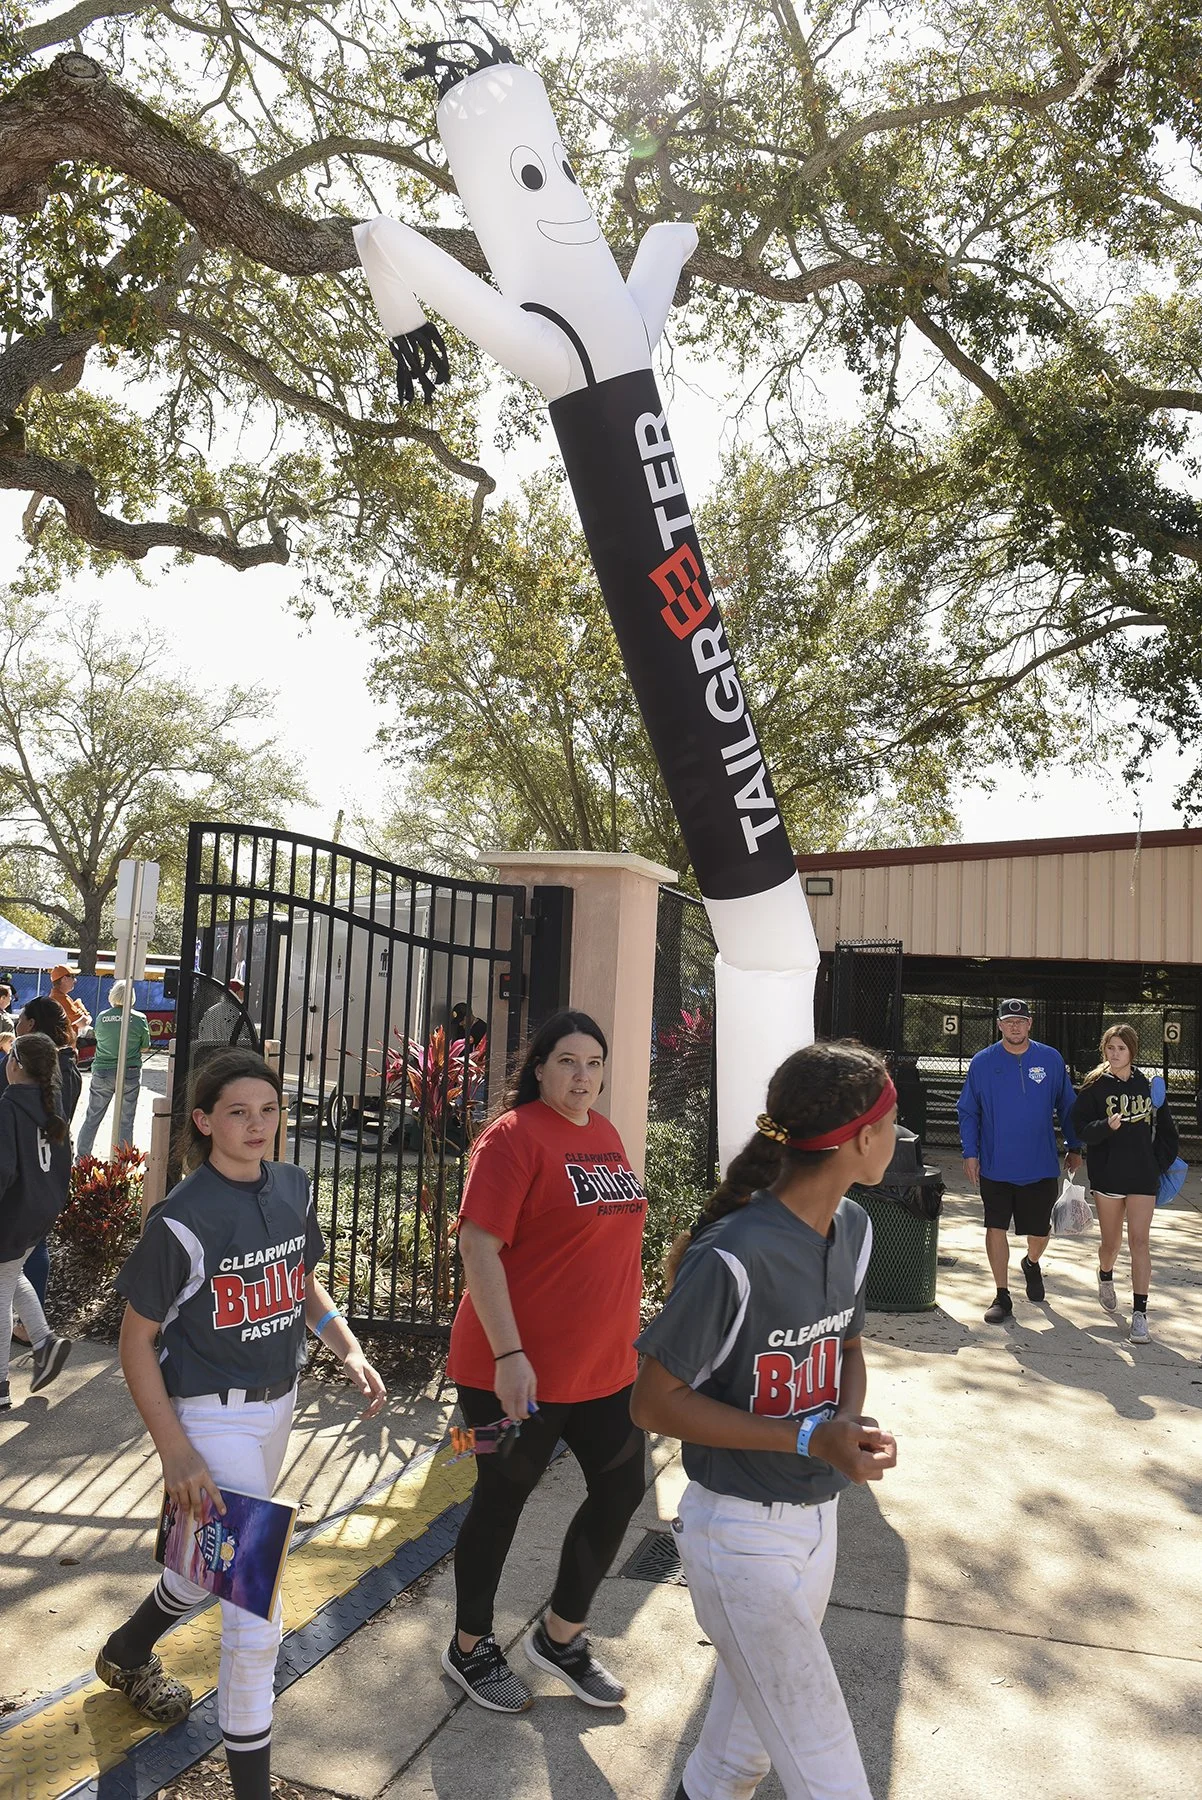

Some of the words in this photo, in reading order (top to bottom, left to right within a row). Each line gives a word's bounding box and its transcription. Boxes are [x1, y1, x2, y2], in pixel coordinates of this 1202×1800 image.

[945, 1017, 956, 1032] 5
[1166, 1025, 1178, 1040] 6
[1106, 1094, 1152, 1118] Elite
[565, 1152, 622, 1163] CLEARWATER
[597, 1203, 643, 1216] FASTPITCH
[241, 1305, 302, 1342] FASTPIH
[750, 1337, 842, 1418] Bull
[204, 1526, 215, 1561] ELITE
